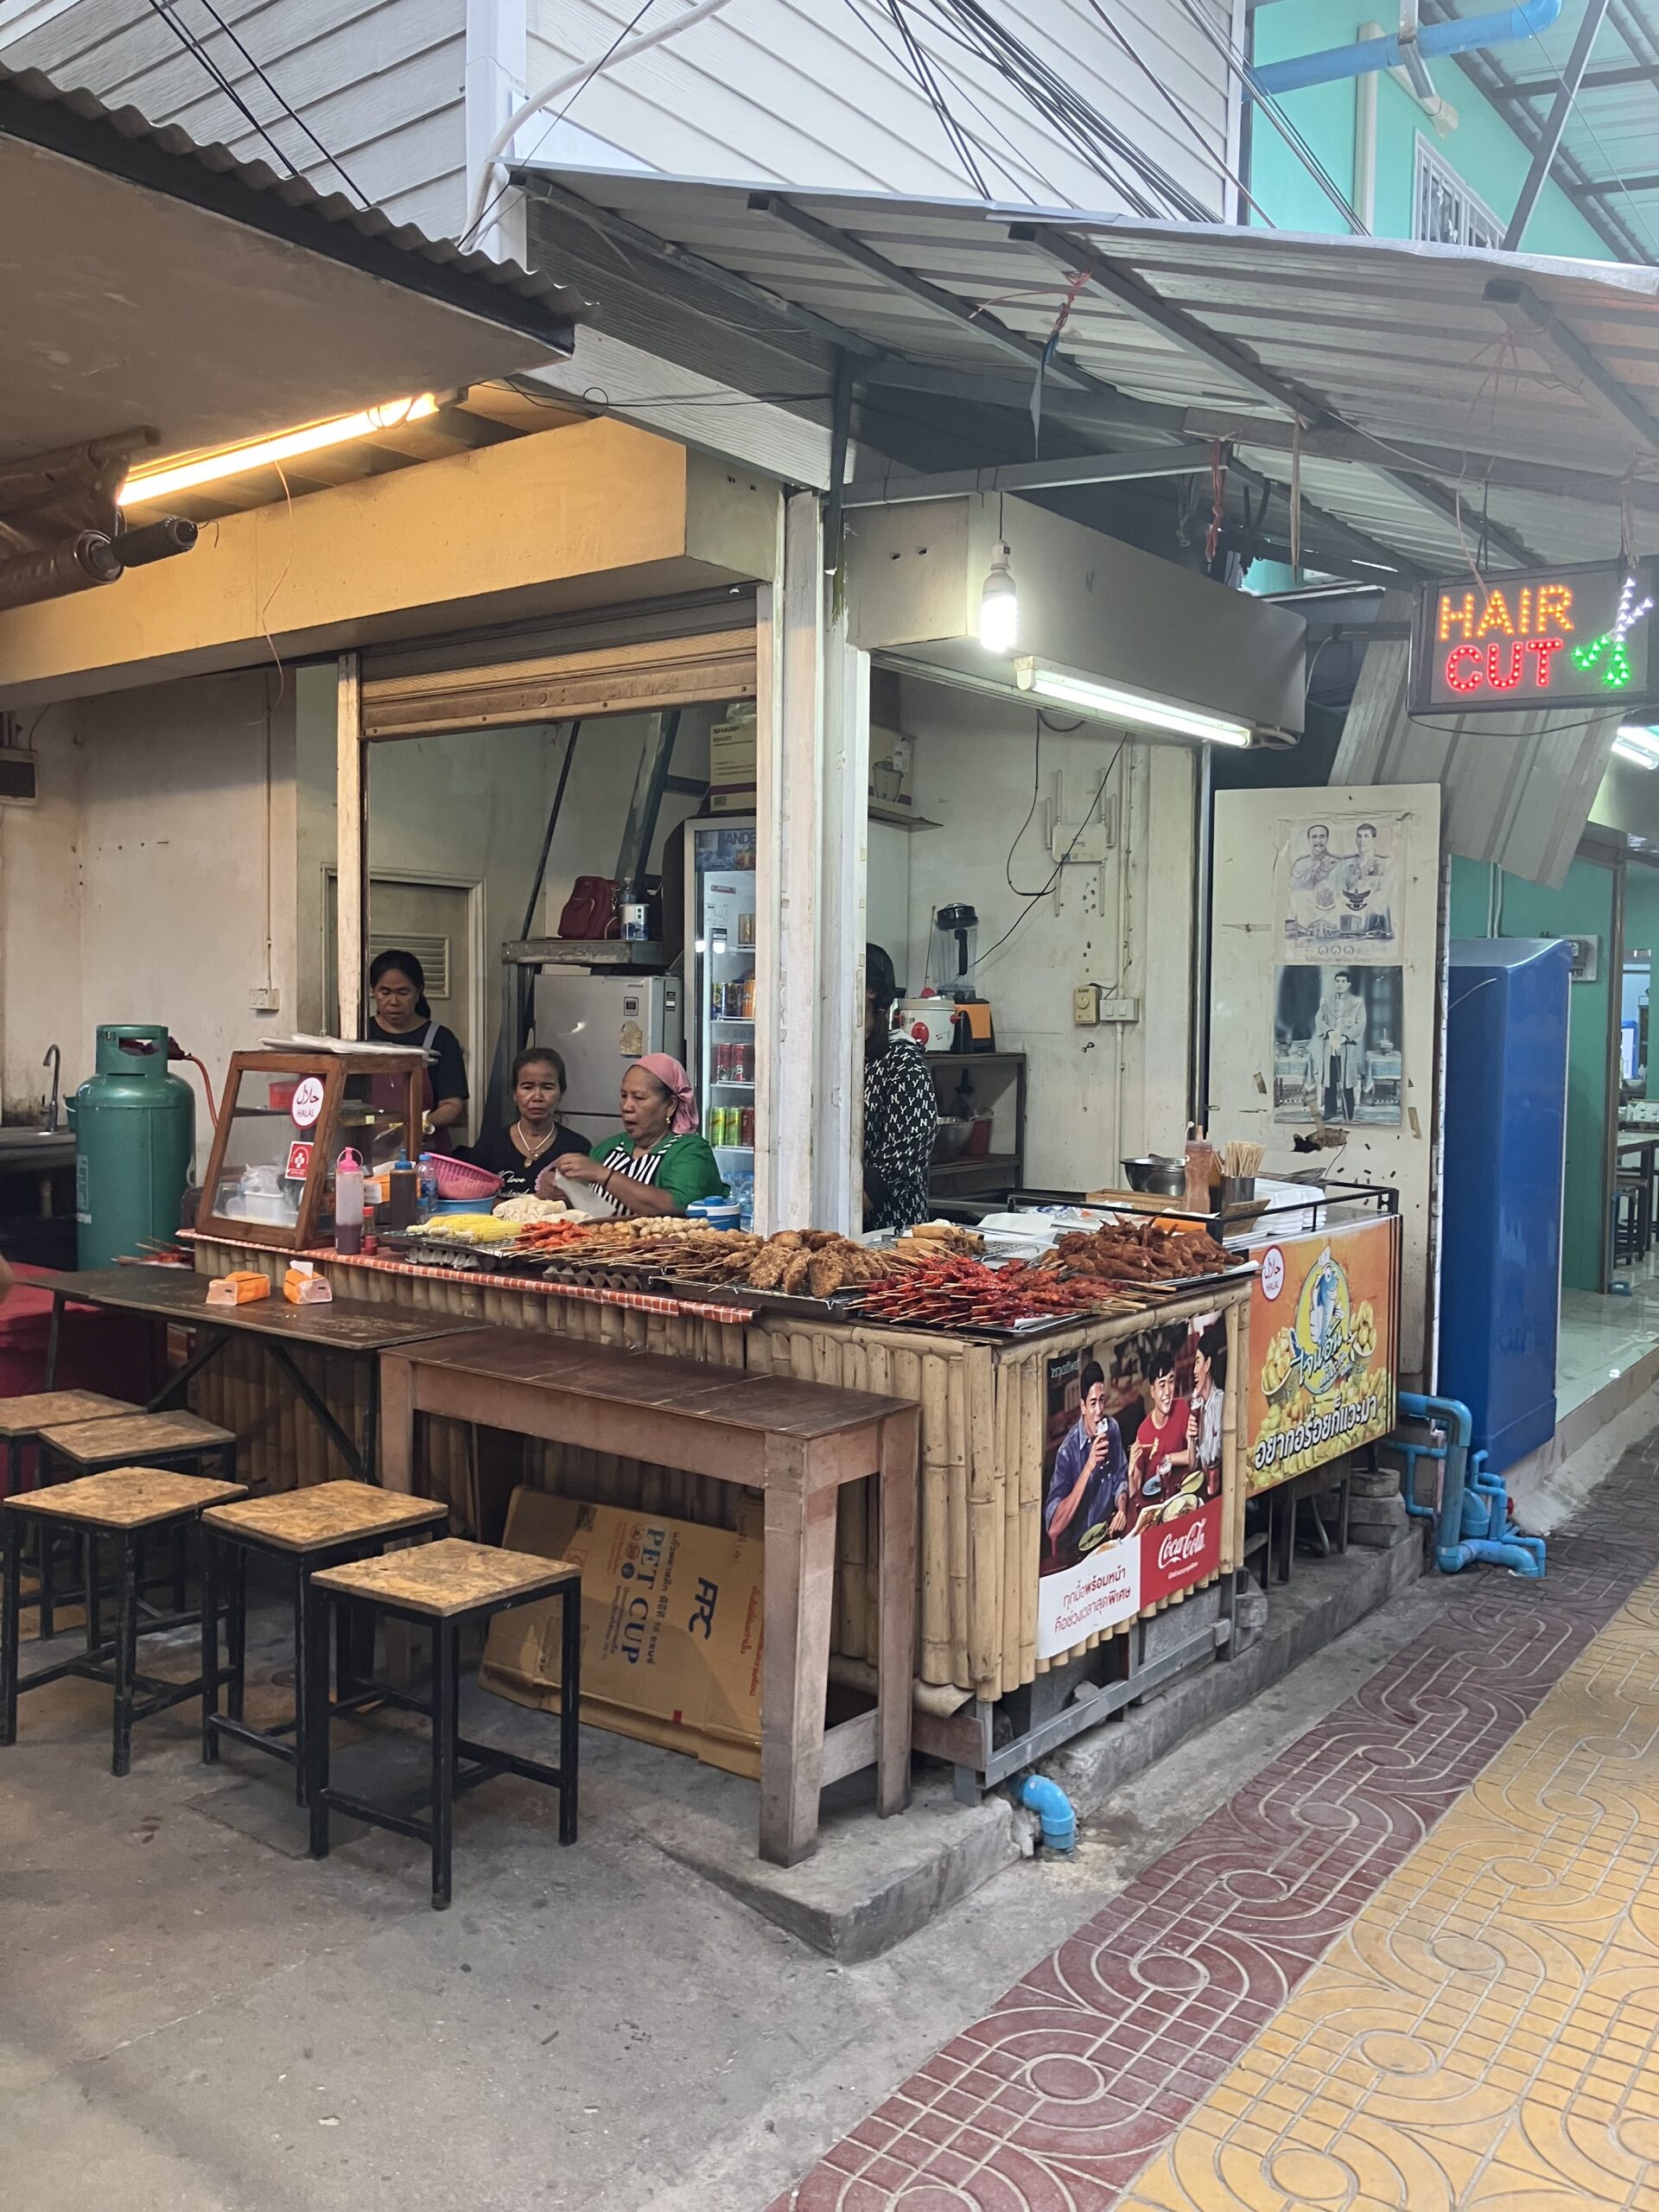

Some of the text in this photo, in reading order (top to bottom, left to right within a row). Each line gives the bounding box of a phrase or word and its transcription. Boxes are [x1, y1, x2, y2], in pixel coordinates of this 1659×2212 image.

[1439, 584, 1574, 640] HAIR
[1446, 639, 1563, 691] CUT
[713, 726, 740, 734] SHARP
[506, 1174, 525, 1183] love
[1255, 1394, 1376, 1470] อยากอร่อยก็แวะมา
[621, 1529, 665, 1664] PET CUP
[1054, 1586, 1131, 1633] คือช่วงเวลาสุดพิเศษ
[1063, 1564, 1127, 1611] ทุกมื้อพร้อมหน้า
